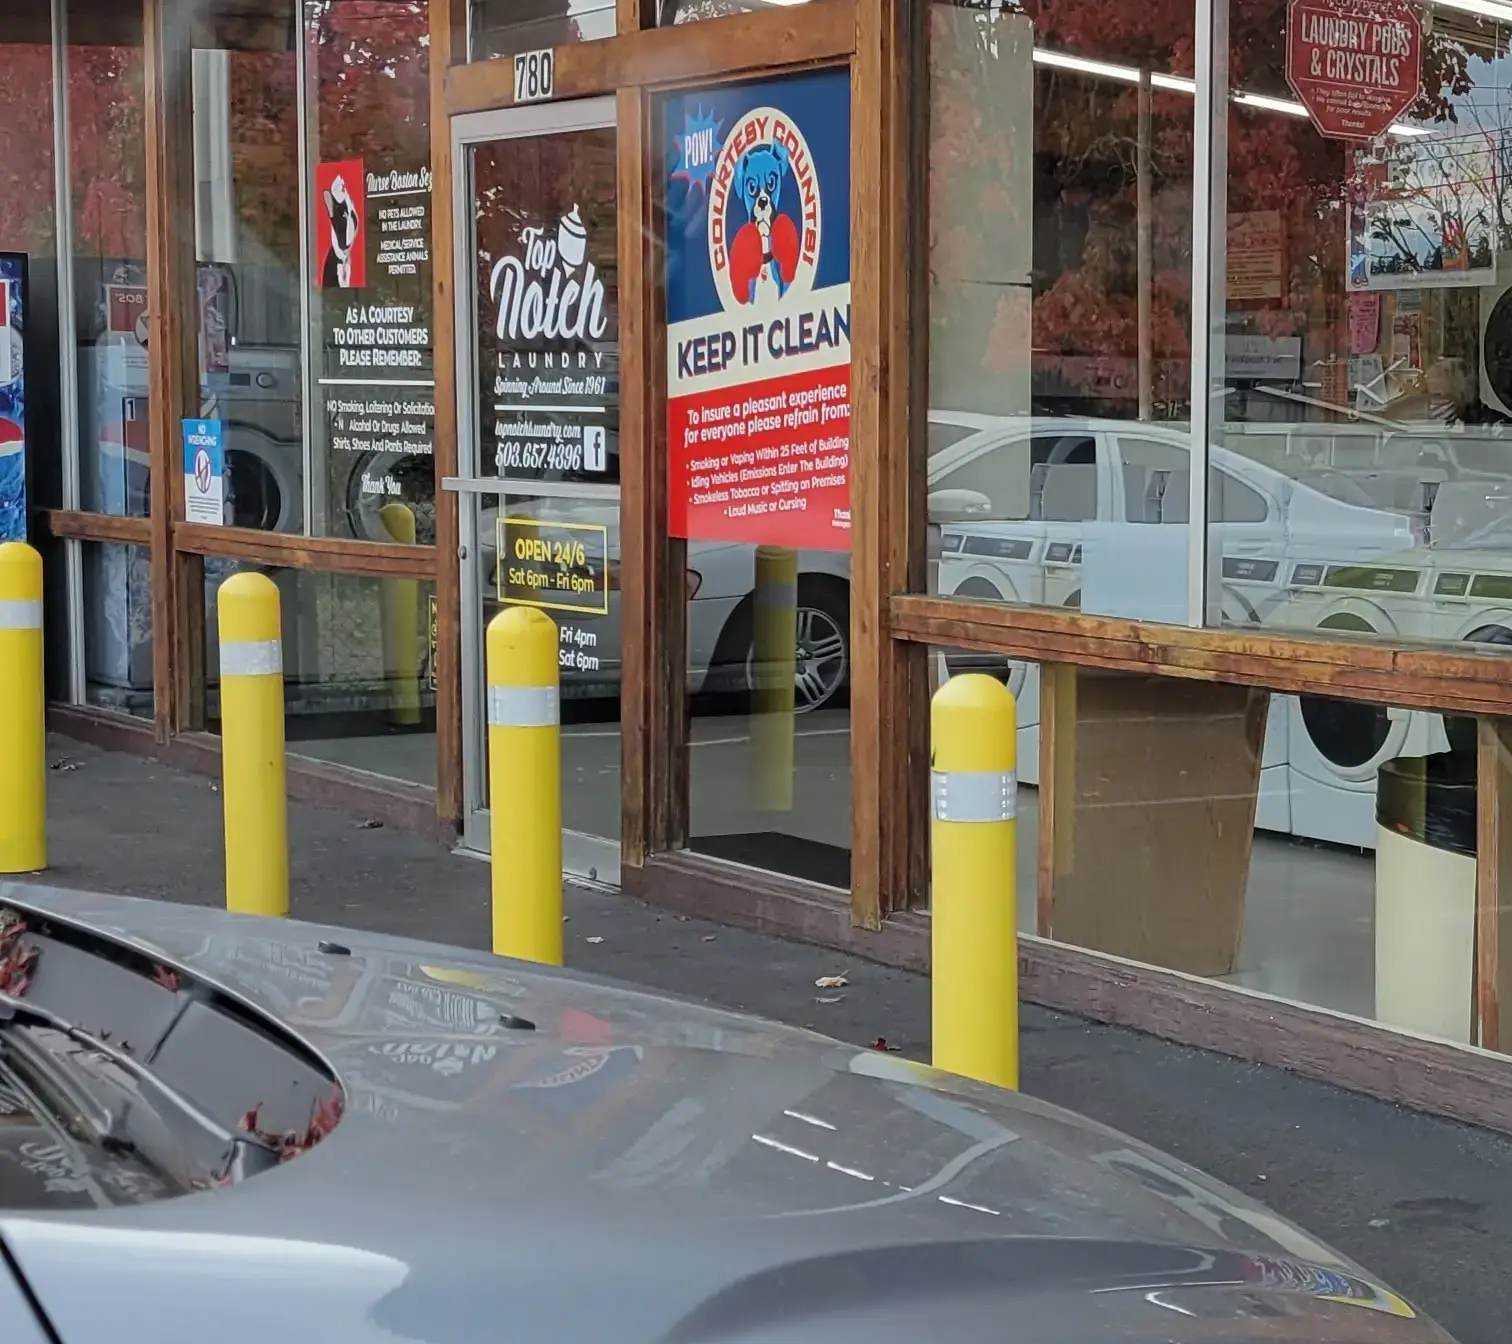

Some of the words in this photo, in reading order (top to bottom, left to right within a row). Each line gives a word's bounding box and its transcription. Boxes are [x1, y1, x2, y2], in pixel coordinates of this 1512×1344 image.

[1301, 12, 1368, 51] LAUNDRY
[1372, 22, 1410, 56] PODS
[516, 52, 551, 99] 780
[1311, 47, 1321, 76] &
[1326, 50, 1399, 86] CRYSTALS
[685, 128, 713, 169] POW!
[366, 173, 389, 192] Nurse
[390, 170, 418, 190] Boston
[379, 209, 387, 220] NO
[387, 208, 399, 219] PETS
[400, 206, 425, 217] ALLOWED
[382, 223, 388, 232] IN
[388, 222, 397, 231] THE
[376, 253, 406, 263] ASSISTANCE
[406, 251, 428, 261] ANIMALS
[518, 226, 556, 278] Top
[490, 256, 607, 340] Notch
[359, 307, 368, 324] A
[369, 305, 414, 324] COURTESY
[347, 327, 375, 345] OTHER
[377, 327, 428, 345] CUSTOMERS
[678, 330, 737, 379] KEEP
[743, 323, 764, 366] IT
[767, 303, 851, 359] CLEAN
[340, 348, 371, 366] PLEASE
[373, 349, 422, 367] REMEMBER:
[498, 352, 603, 369] LAUNDRY
[494, 376, 528, 397] Spinning
[524, 376, 561, 398] Around
[562, 377, 584, 395] Since
[585, 376, 606, 395] 1961
[327, 400, 336, 412] NO
[366, 400, 393, 416] Loitering
[394, 402, 401, 415] Or
[688, 409, 699, 425] To
[702, 405, 730, 423] insure
[733, 406, 740, 416] a
[742, 391, 786, 418] pleasant
[789, 384, 847, 407] experience
[349, 419, 371, 432] Alcohol
[373, 420, 380, 432] Or
[382, 420, 400, 435] Drugs
[401, 421, 426, 435] Allowed
[494, 420, 581, 444] topnotchlaundry.com
[684, 427, 698, 448] for
[701, 423, 745, 442] everyone
[748, 416, 782, 436] please
[783, 407, 818, 429] refrain
[821, 403, 850, 425] from:
[352, 437, 371, 451] Shoes
[371, 438, 384, 452] And
[385, 439, 403, 453] Pants
[404, 440, 432, 456] Required
[494, 441, 581, 471] 503.657.4396
[690, 456, 719, 472] Smoking
[721, 458, 729, 467] or
[730, 453, 754, 466] Vaping
[756, 446, 779, 460] Within
[780, 444, 789, 457] 25
[791, 443, 808, 455] Feet
[809, 442, 817, 454] of
[819, 437, 849, 452] Building
[691, 476, 710, 489] Idling
[711, 471, 739, 485] Vehicles
[740, 466, 777, 482] (Emissions
[778, 463, 798, 474] Enter
[800, 460, 814, 471] The
[815, 454, 848, 470] Building)
[362, 473, 385, 494] Thank
[385, 475, 401, 496] You
[693, 489, 729, 505] Smokeless
[730, 486, 760, 499] Tobacco
[762, 486, 769, 495] or
[771, 480, 799, 495] Spitting
[800, 479, 810, 489] on
[812, 473, 846, 487] Premises
[728, 504, 746, 518] Loud
[748, 502, 768, 515] Music
[769, 502, 777, 511] or
[778, 497, 806, 512] Cursing
[515, 538, 551, 562] OPEN
[554, 540, 585, 568] 24/6
[509, 568, 525, 585] Sat
[526, 570, 549, 590] 6pm
[557, 573, 570, 590] Fri
[571, 574, 594, 595] 6pm
[560, 626, 573, 643] Fri
[574, 628, 597, 648] 4pm
[558, 649, 575, 667] Sat
[576, 652, 599, 672] 6pm
